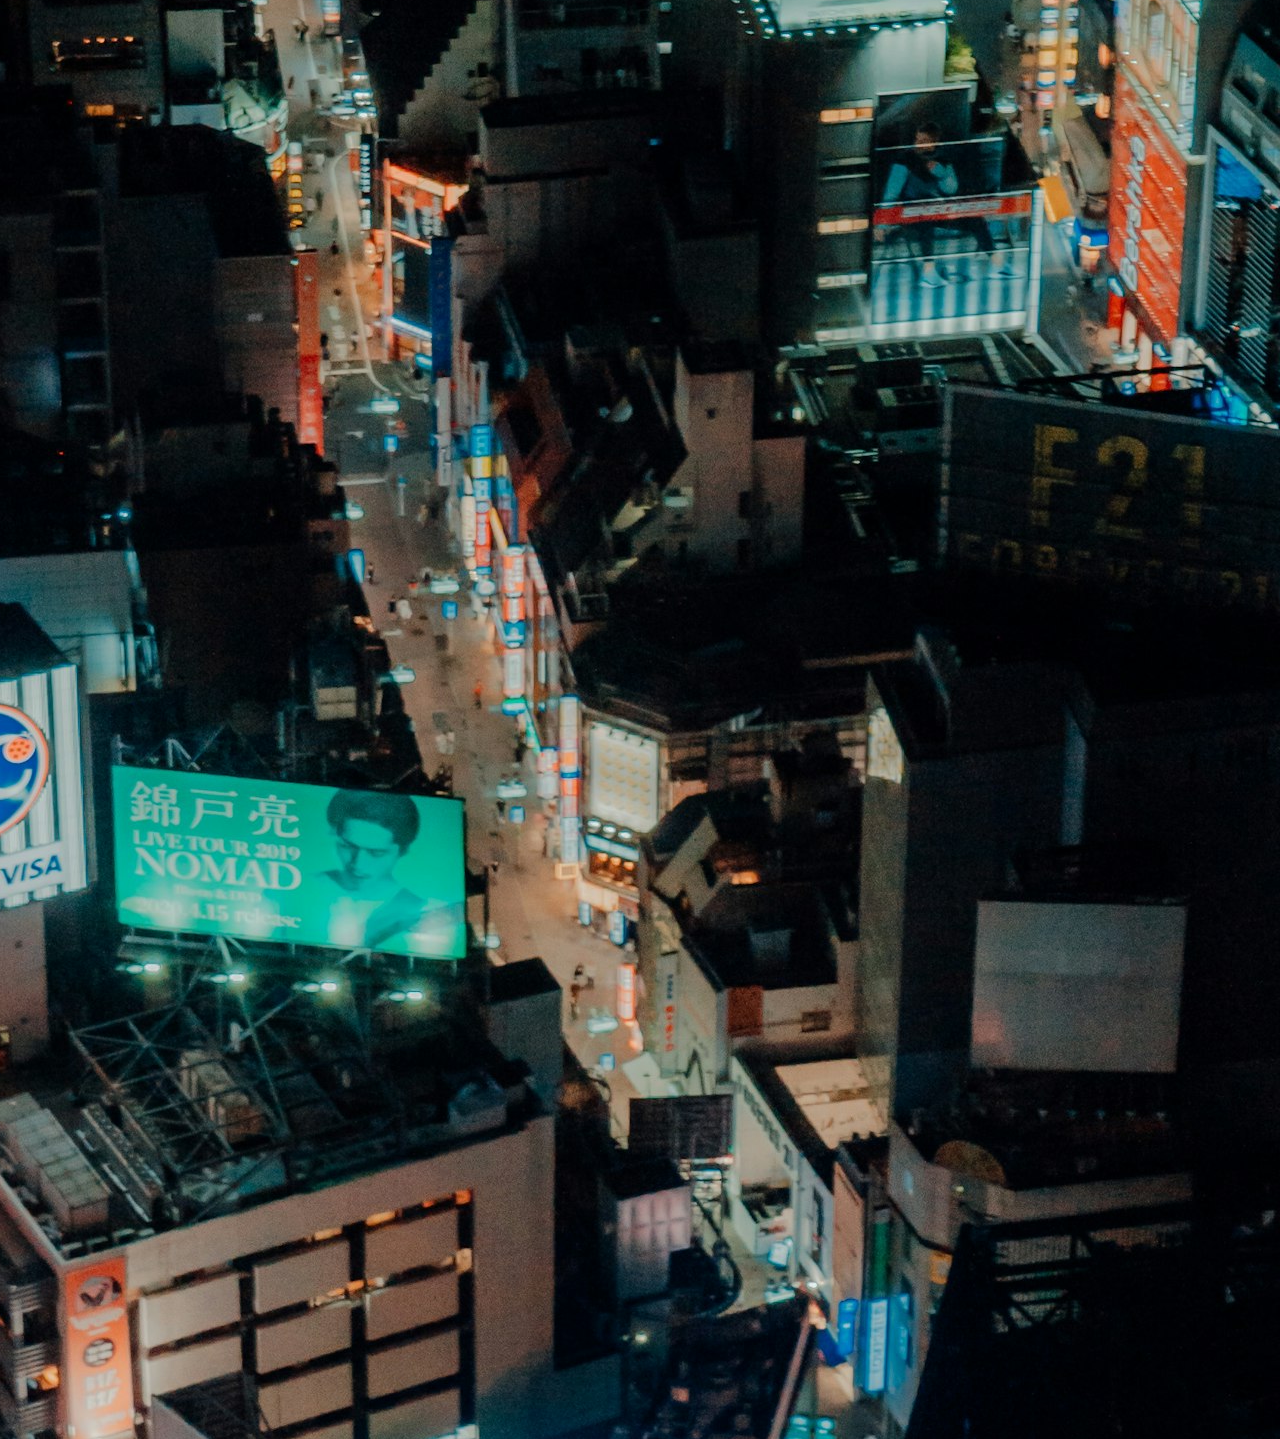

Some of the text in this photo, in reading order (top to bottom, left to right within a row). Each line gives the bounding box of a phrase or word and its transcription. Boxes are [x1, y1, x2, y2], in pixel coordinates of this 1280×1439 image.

[132, 828, 302, 861] LIVE TOUR 2019
[0, 855, 62, 885] VISA
[133, 847, 303, 891] NOMAD
